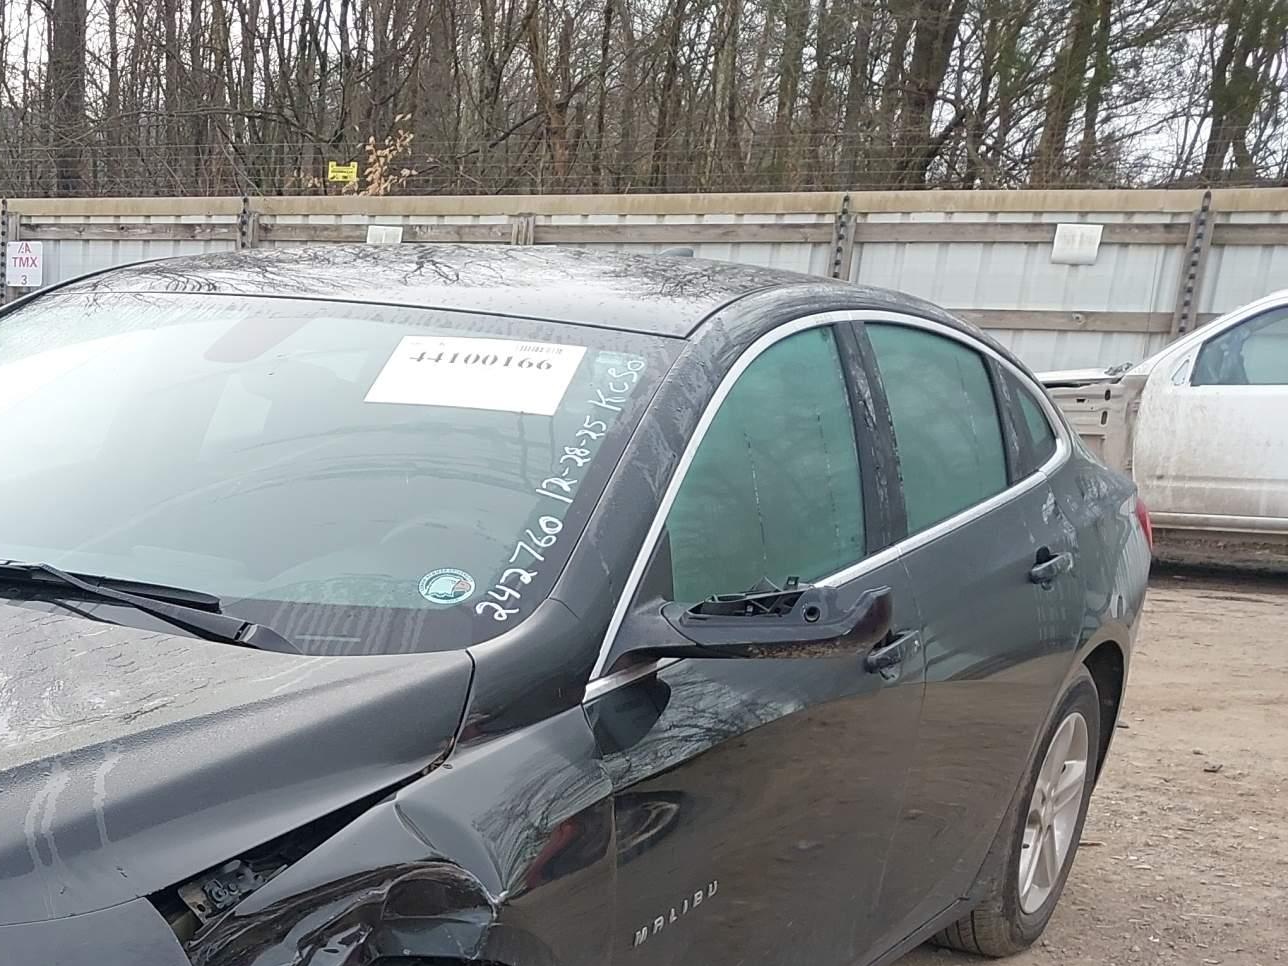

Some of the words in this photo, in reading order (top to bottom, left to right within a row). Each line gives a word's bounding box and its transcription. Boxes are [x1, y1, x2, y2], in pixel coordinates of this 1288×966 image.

[12, 256, 38, 268] TMX
[21, 275, 28, 285] 3
[409, 350, 553, 371] 44100166
[475, 516, 563, 621] 242760
[535, 415, 607, 504] 12-28-25
[634, 880, 718, 948] MALIBU
